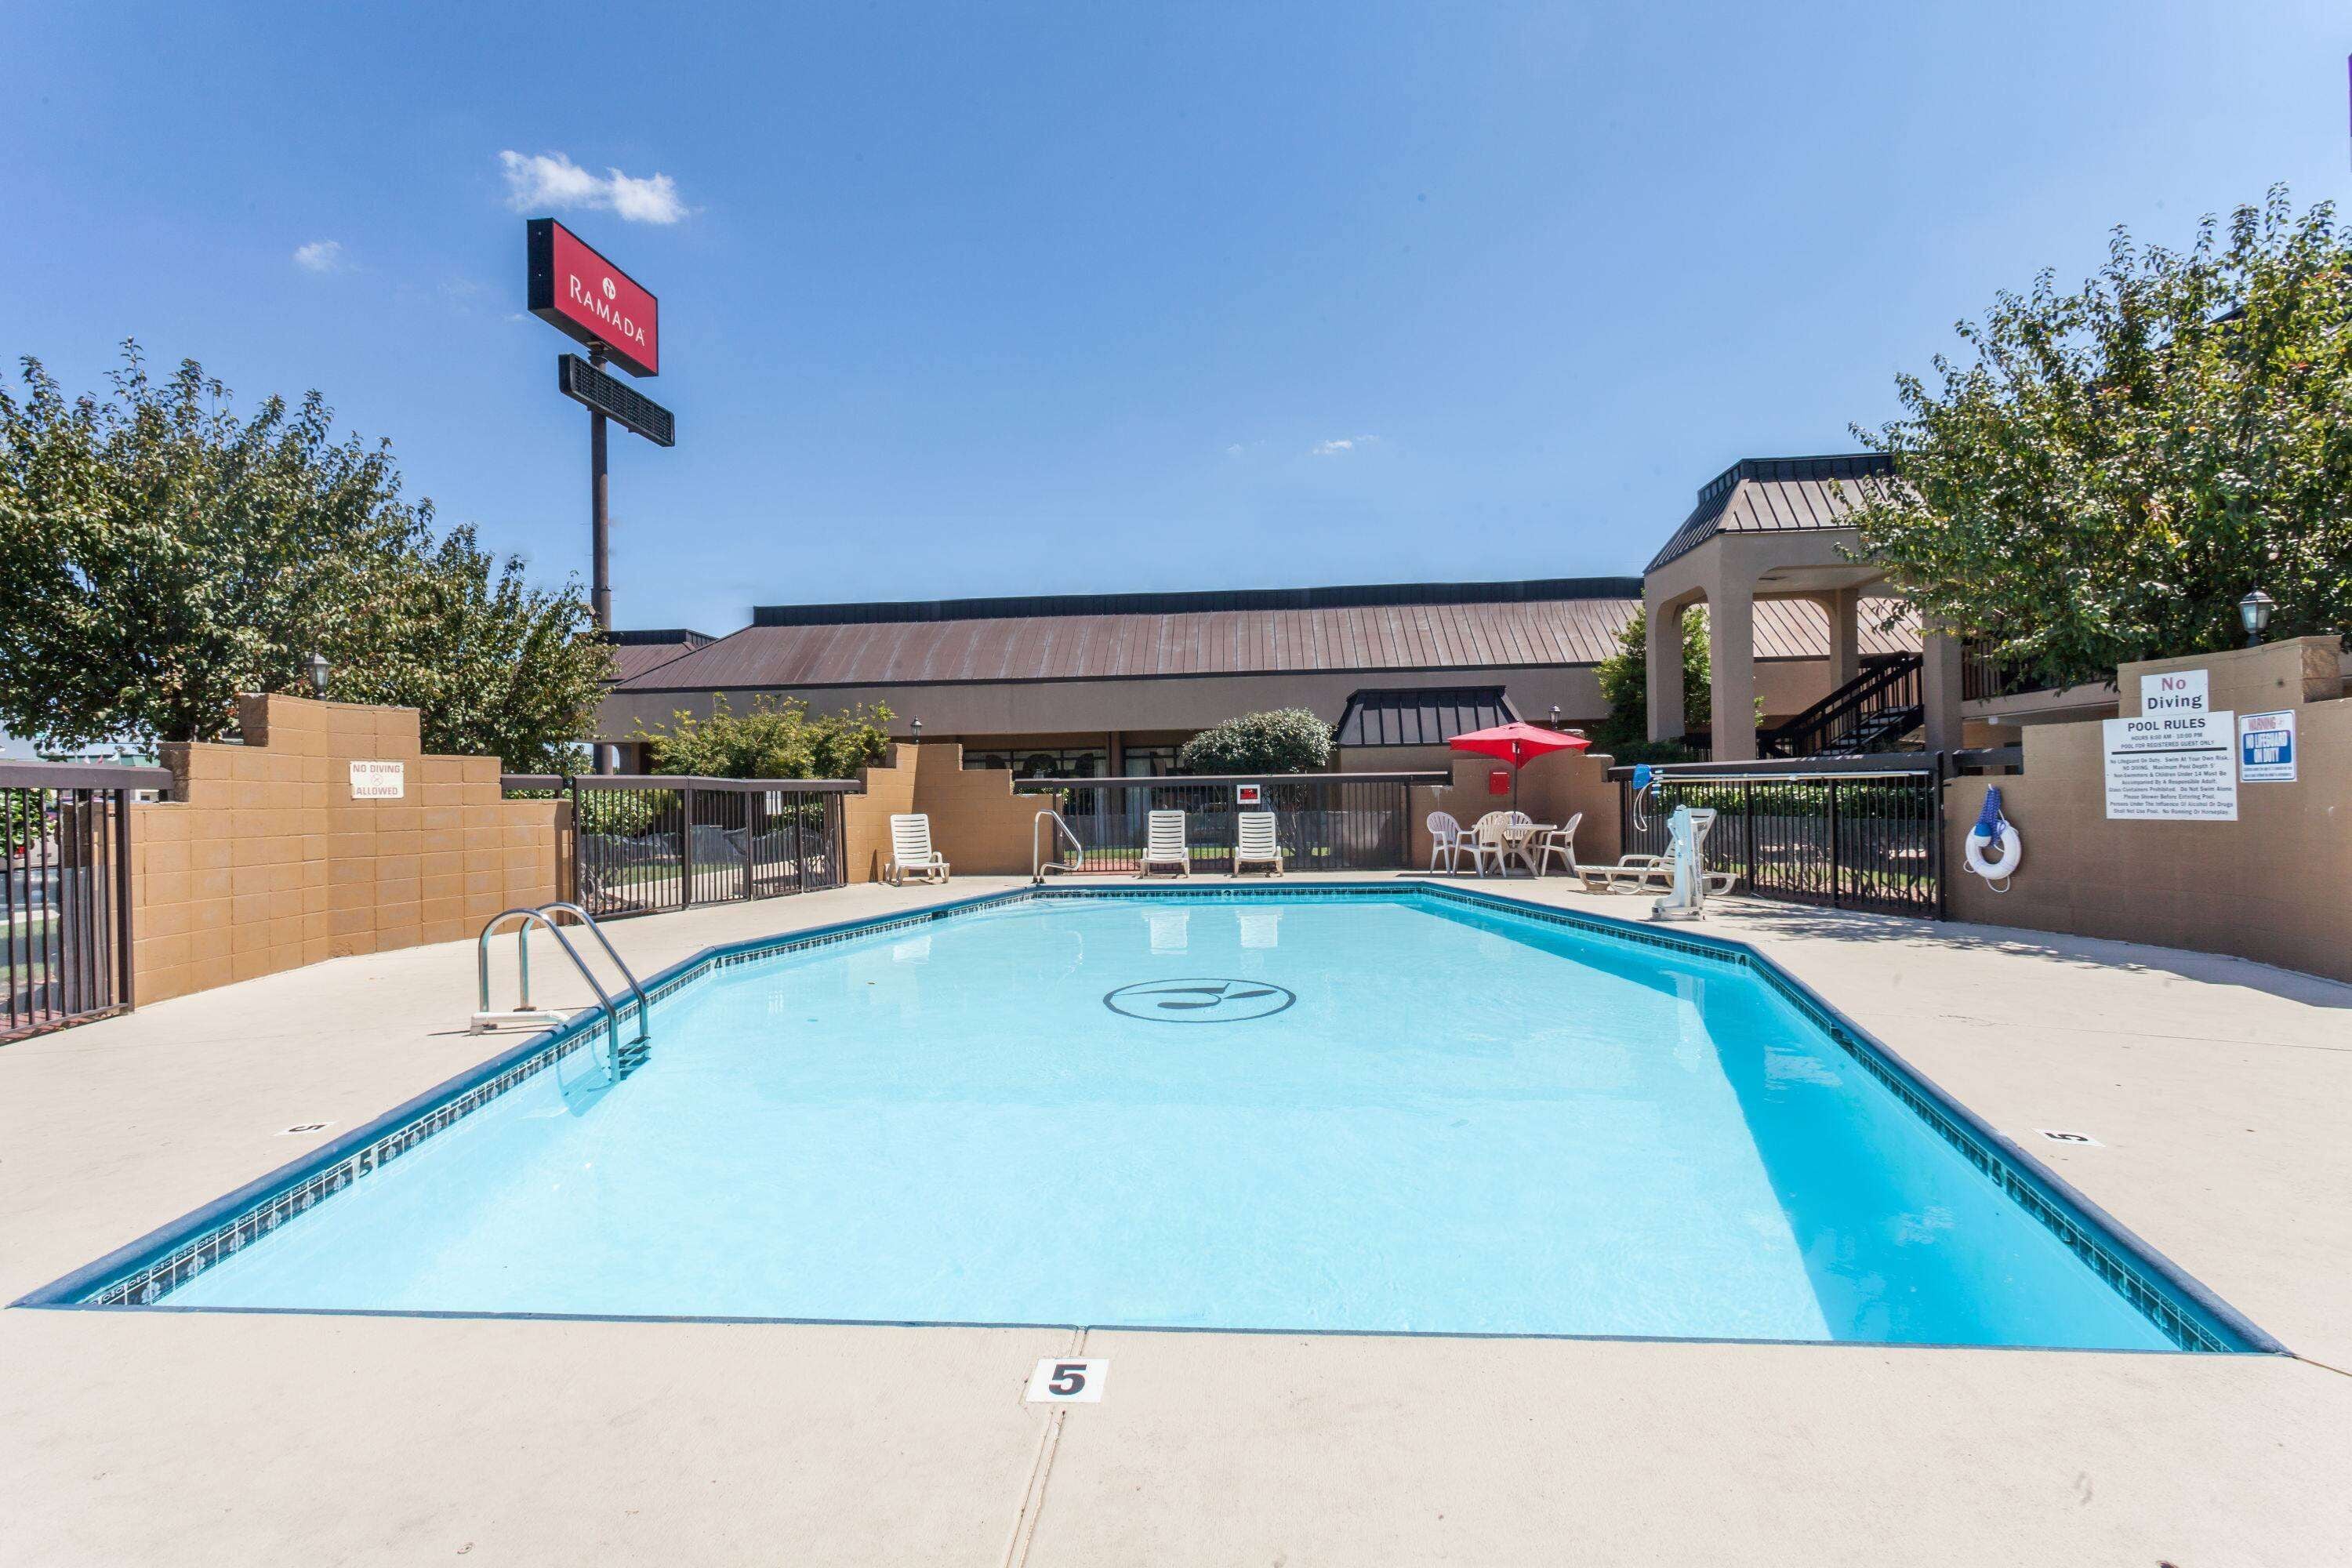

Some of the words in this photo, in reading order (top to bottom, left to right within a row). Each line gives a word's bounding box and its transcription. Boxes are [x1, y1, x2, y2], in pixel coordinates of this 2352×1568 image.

[570, 274, 644, 346] RAMADA
[2161, 677, 2186, 691] No
[2148, 695, 2202, 709] Diving
[2128, 721, 2159, 731] POOL
[2164, 718, 2205, 729] RULES
[353, 764, 367, 773] NO
[370, 764, 401, 773] DIVING
[714, 956, 723, 968] 4
[2045, 1132, 2088, 1142] 5
[358, 1147, 373, 1179] 5
[1991, 1158, 2003, 1188] 5
[1048, 1364, 1087, 1396] 5
